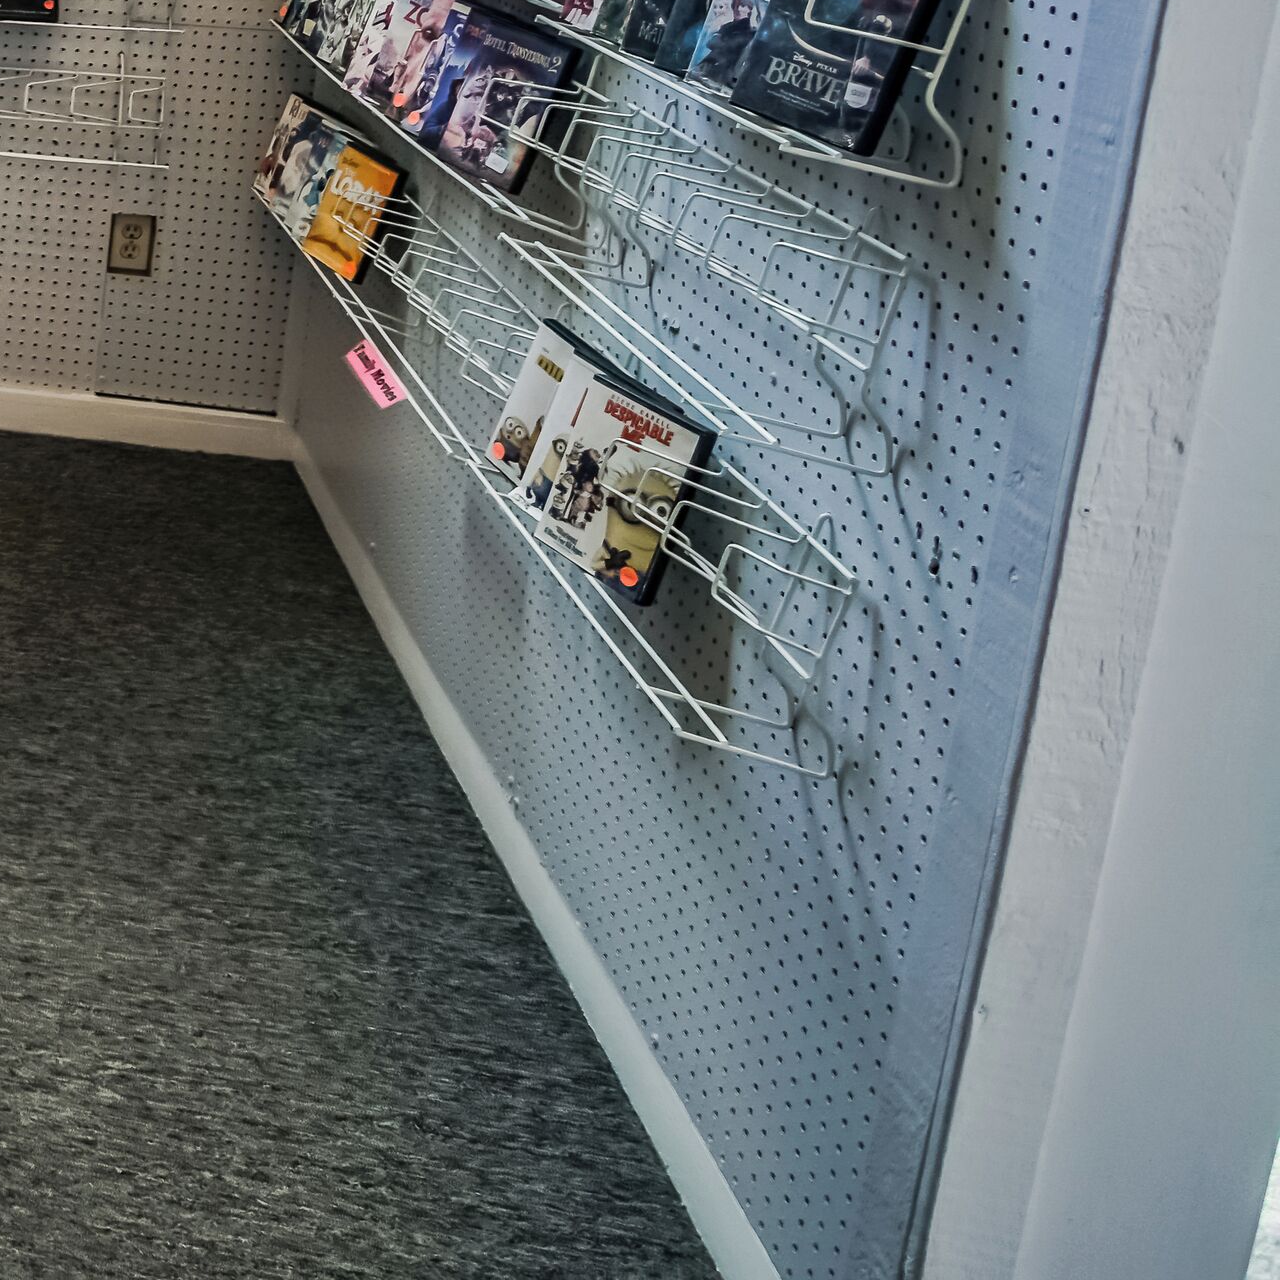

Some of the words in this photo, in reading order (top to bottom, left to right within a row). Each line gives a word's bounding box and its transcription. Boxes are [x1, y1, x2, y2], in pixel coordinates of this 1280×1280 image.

[483, 33, 506, 54] HOTEL
[549, 56, 562, 74] 2
[816, 62, 838, 74] PIXAR
[765, 55, 846, 109] BRAVE
[370, 367, 397, 403] Movies
[604, 398, 675, 447] DESPICABLE
[611, 393, 635, 413] STEVE
[639, 408, 671, 430] CARELL
